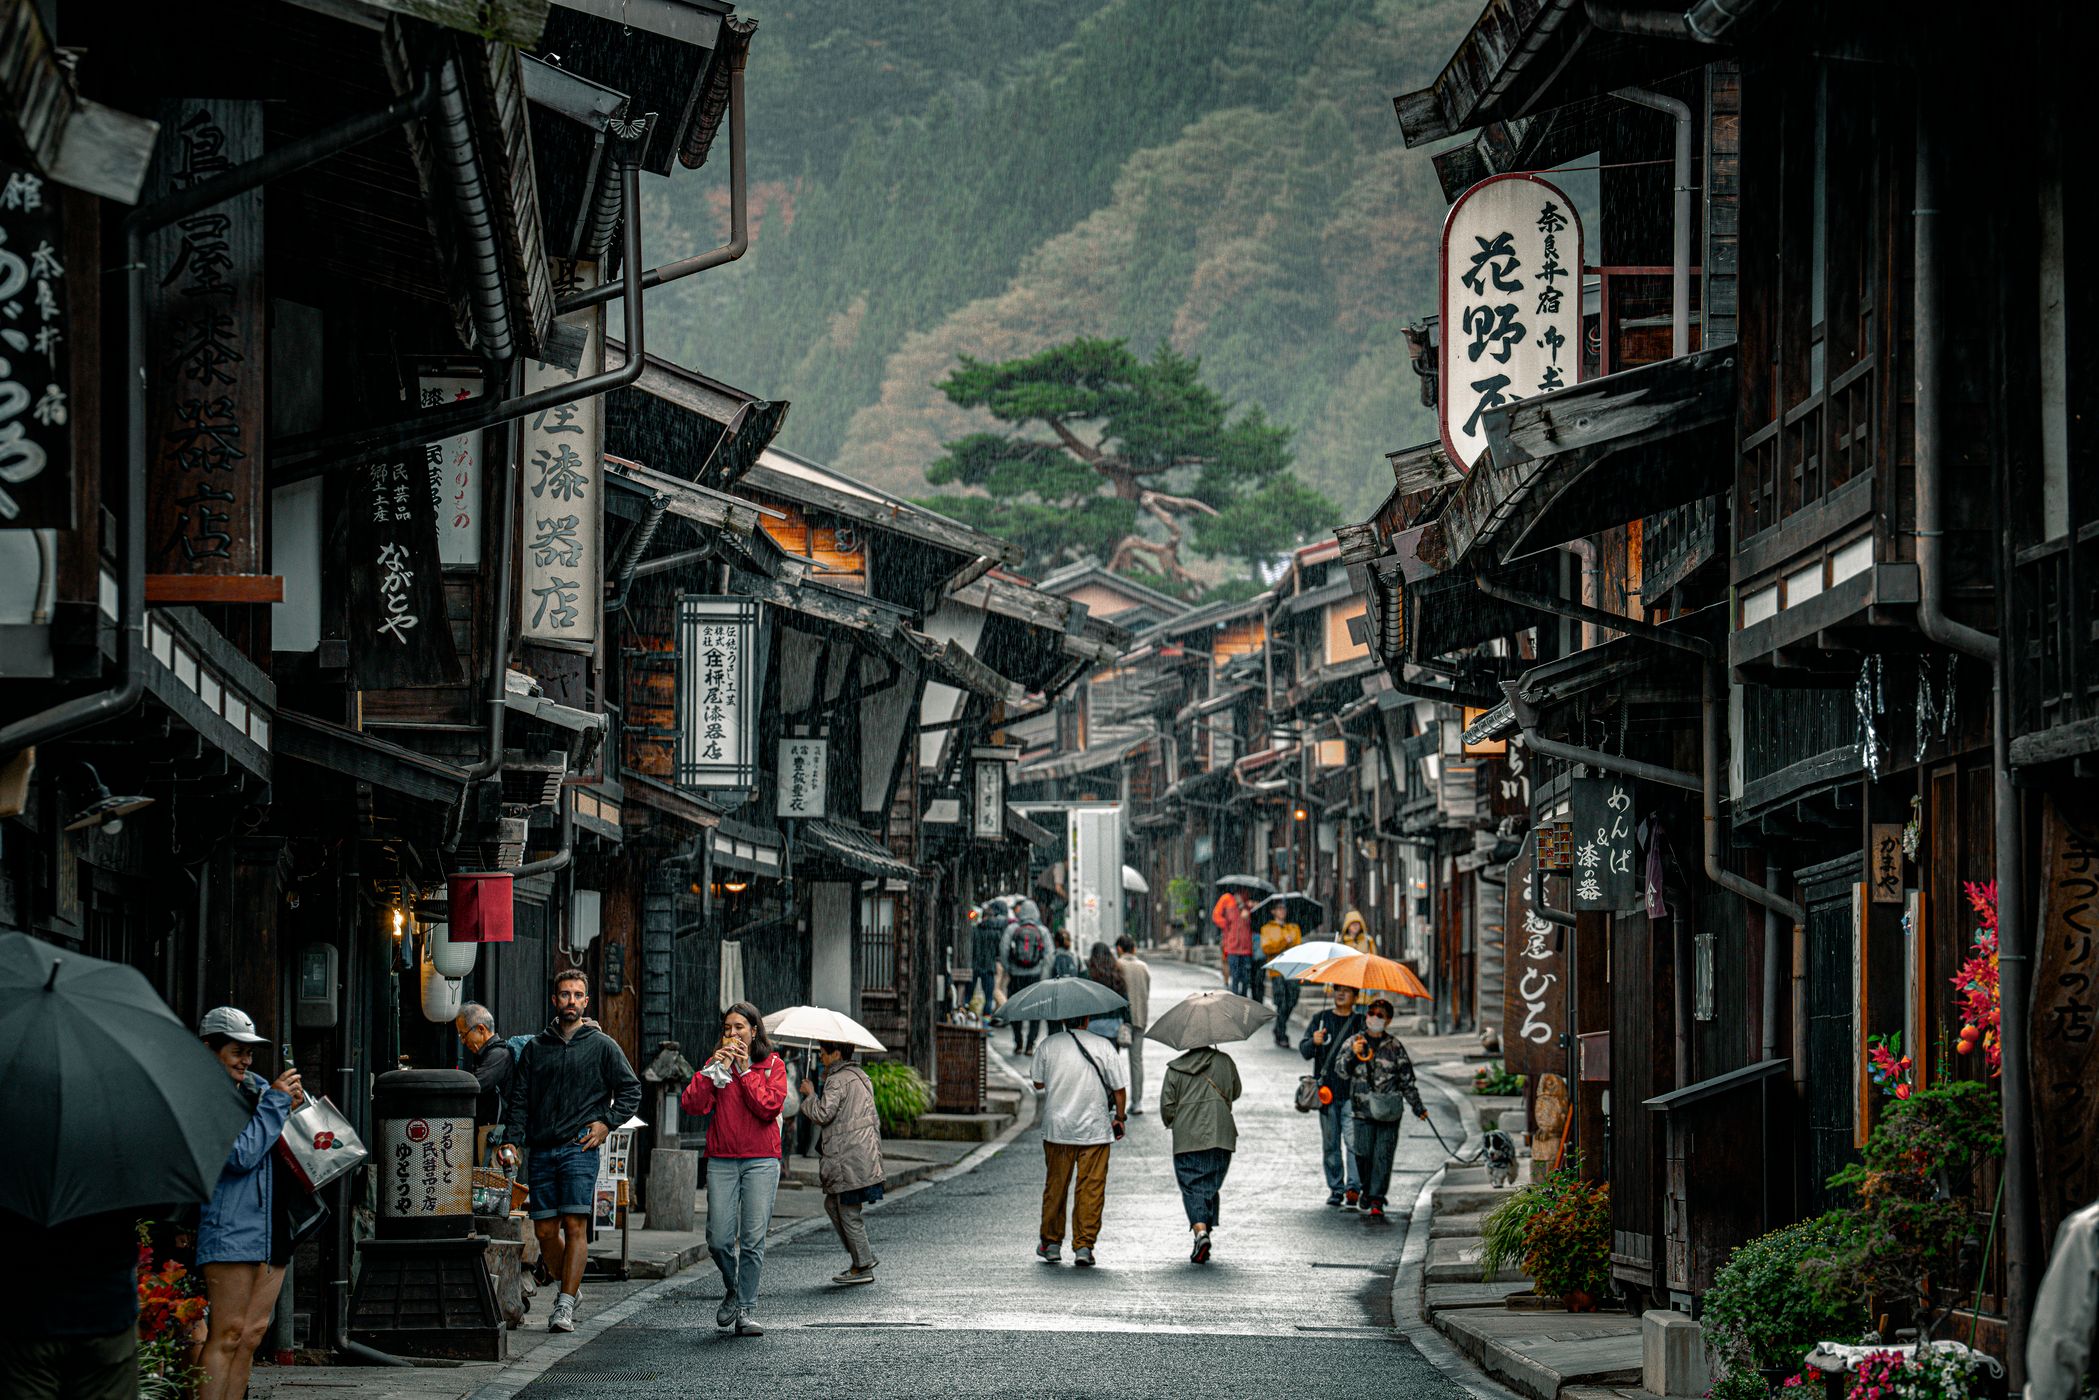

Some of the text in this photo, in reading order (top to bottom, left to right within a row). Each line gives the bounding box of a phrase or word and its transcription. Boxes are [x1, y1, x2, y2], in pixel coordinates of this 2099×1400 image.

[1535, 201, 1569, 315] 奈良井宿
[393, 462, 412, 521] 民芸品
[377, 541, 419, 645] ながとや
[1596, 828, 1609, 847] &
[1608, 785, 1632, 874] めんぱ
[1576, 841, 1603, 900] 漆の器
[1877, 836, 1900, 894] かまや
[421, 1142, 437, 1211] 民芸品の店
[441, 1121, 453, 1183] うるしと
